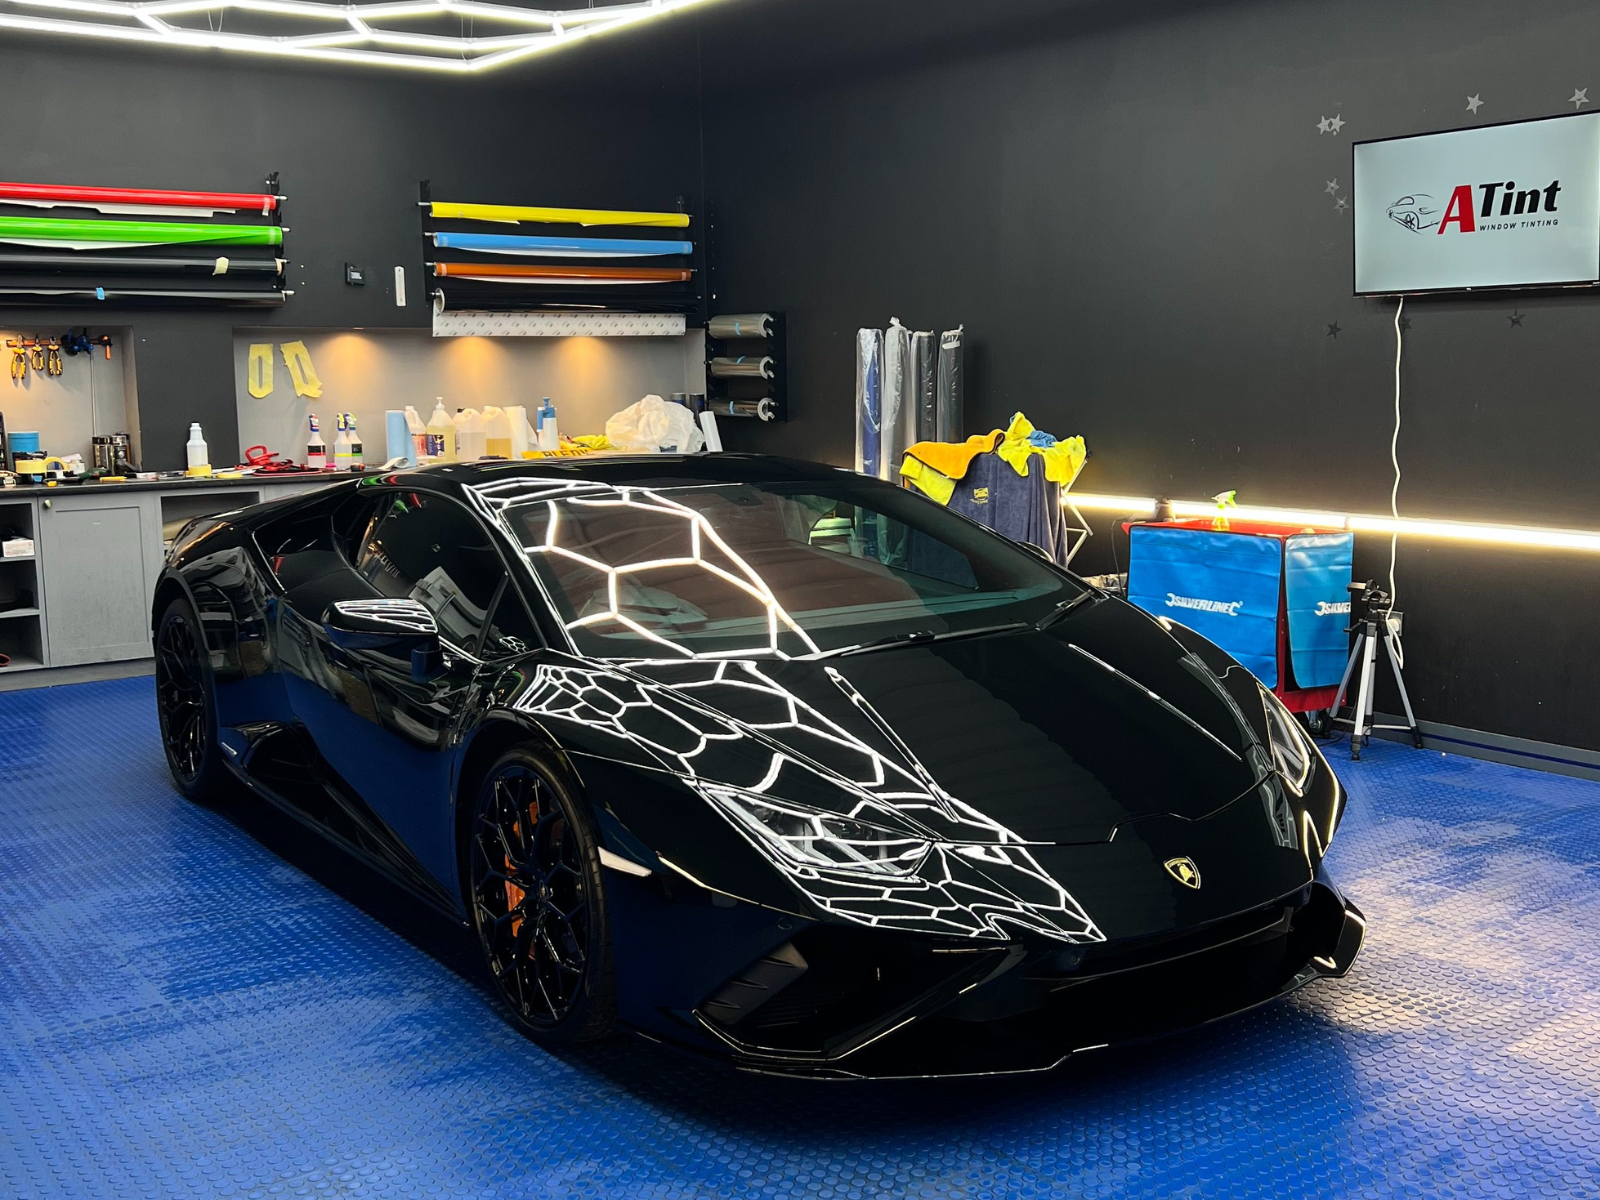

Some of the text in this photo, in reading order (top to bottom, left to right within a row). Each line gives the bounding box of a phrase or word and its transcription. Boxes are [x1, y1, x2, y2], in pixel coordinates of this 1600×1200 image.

[1479, 219, 1559, 232] WINDOW TINTING
[1174, 595, 1231, 614] SILVERLINE
[1324, 602, 1351, 615] SILVE
